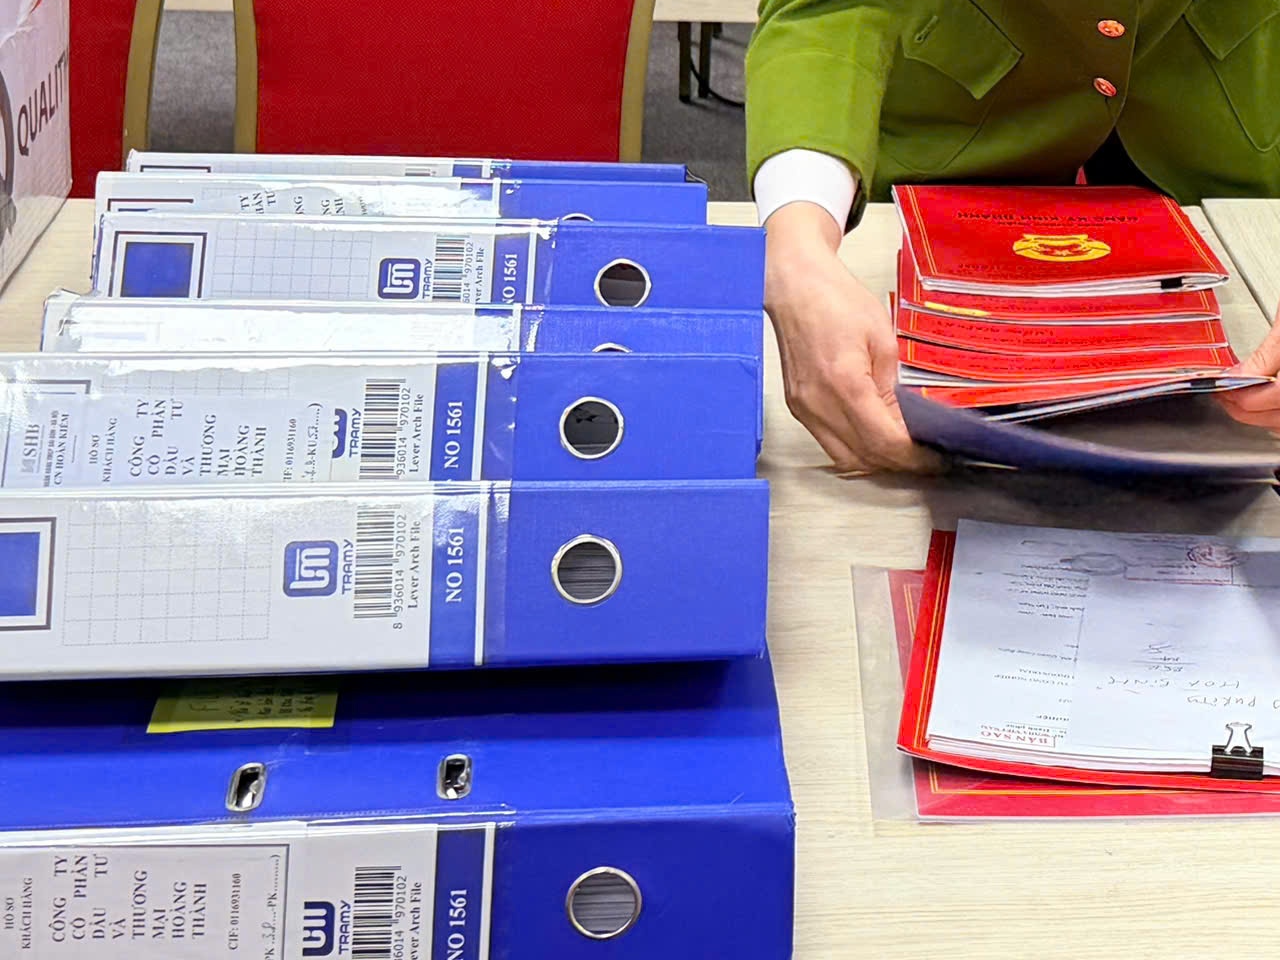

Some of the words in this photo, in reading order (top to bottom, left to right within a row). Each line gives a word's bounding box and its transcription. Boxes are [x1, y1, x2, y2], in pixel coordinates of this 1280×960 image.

[464, 242, 474, 273] 970102
[475, 246, 485, 263] File
[503, 253, 518, 281] 1561
[475, 266, 484, 287] Arch
[462, 282, 471, 303] 6014
[475, 288, 483, 303] ver
[400, 387, 411, 426] 970102
[413, 394, 424, 413] File
[447, 401, 463, 435] 1561
[128, 436, 145, 477] CÔNG
[137, 399, 149, 418] TY
[413, 415, 423, 442] Arch
[180, 456, 195, 476] VÀ
[396, 437, 407, 476] 936014
[409, 445, 420, 473] Lever
[444, 441, 461, 469] NO
[396, 514, 407, 558] 970102
[409, 520, 421, 541] File
[447, 527, 464, 565] 1561
[409, 544, 421, 573] Arch
[394, 569, 405, 613] 936014
[408, 576, 419, 609] Lever
[445, 572, 463, 603] NO
[54, 855, 68, 877] TY
[131, 870, 148, 940] THƯƠNG
[393, 875, 408, 919] 970102
[410, 882, 423, 904] File
[449, 889, 467, 926] 1561
[48, 897, 67, 943] CÔNG
[152, 908, 169, 939] MẠI
[169, 881, 187, 939] HOÀNG
[188, 883, 207, 940] THÀNH
[409, 906, 421, 935] Arch
[109, 917, 127, 940] VÀ
[393, 929, 406, 960] 6014
[447, 936, 466, 960] NO
